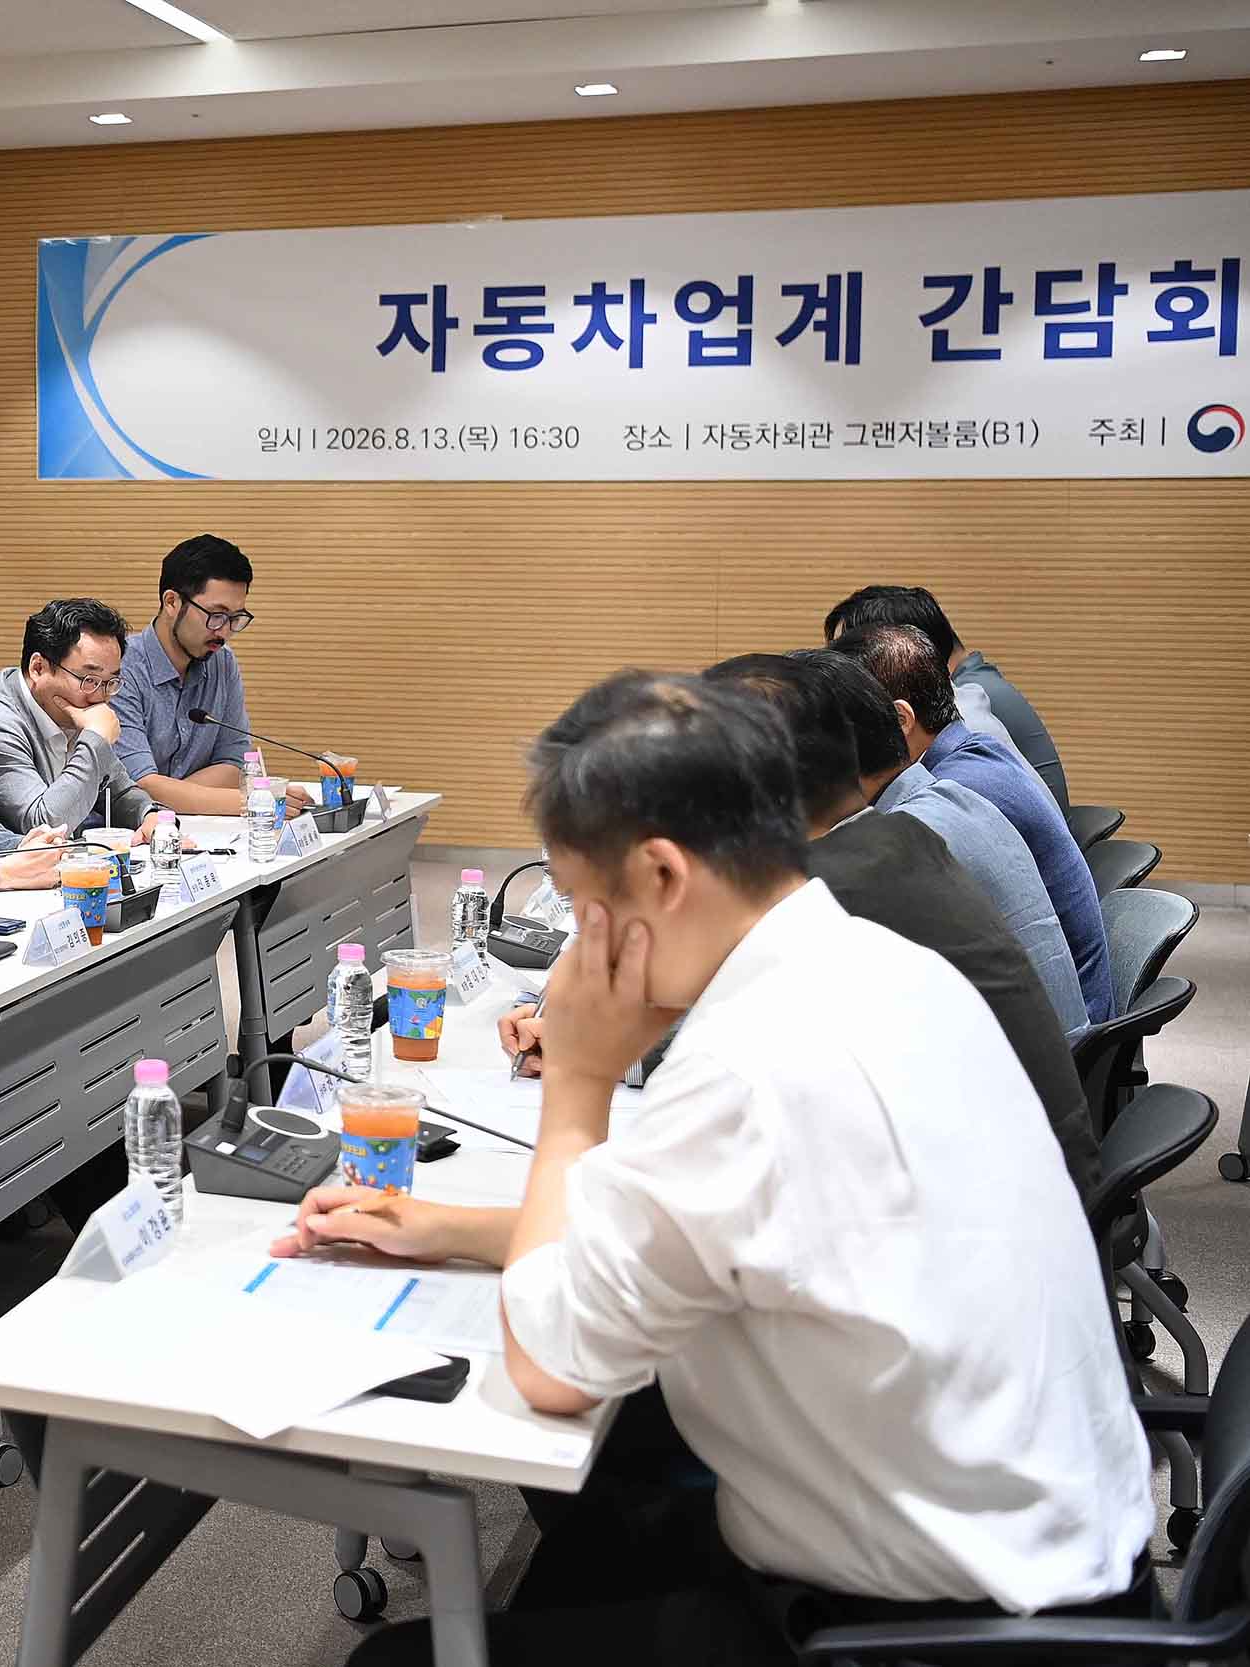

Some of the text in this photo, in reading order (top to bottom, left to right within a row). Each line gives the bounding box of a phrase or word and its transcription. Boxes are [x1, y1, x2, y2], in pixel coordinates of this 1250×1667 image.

[375, 257, 1241, 374] 자동차업계 간담회
[257, 427, 302, 452] 일시
[325, 424, 499, 453] 2026.8.13.(목)
[509, 425, 580, 449] 16:30
[623, 423, 673, 452] 장소
[701, 421, 834, 451] 자동차회관
[842, 418, 1039, 450] 그랜저볼룸(B1)
[1088, 416, 1146, 447] 주최
